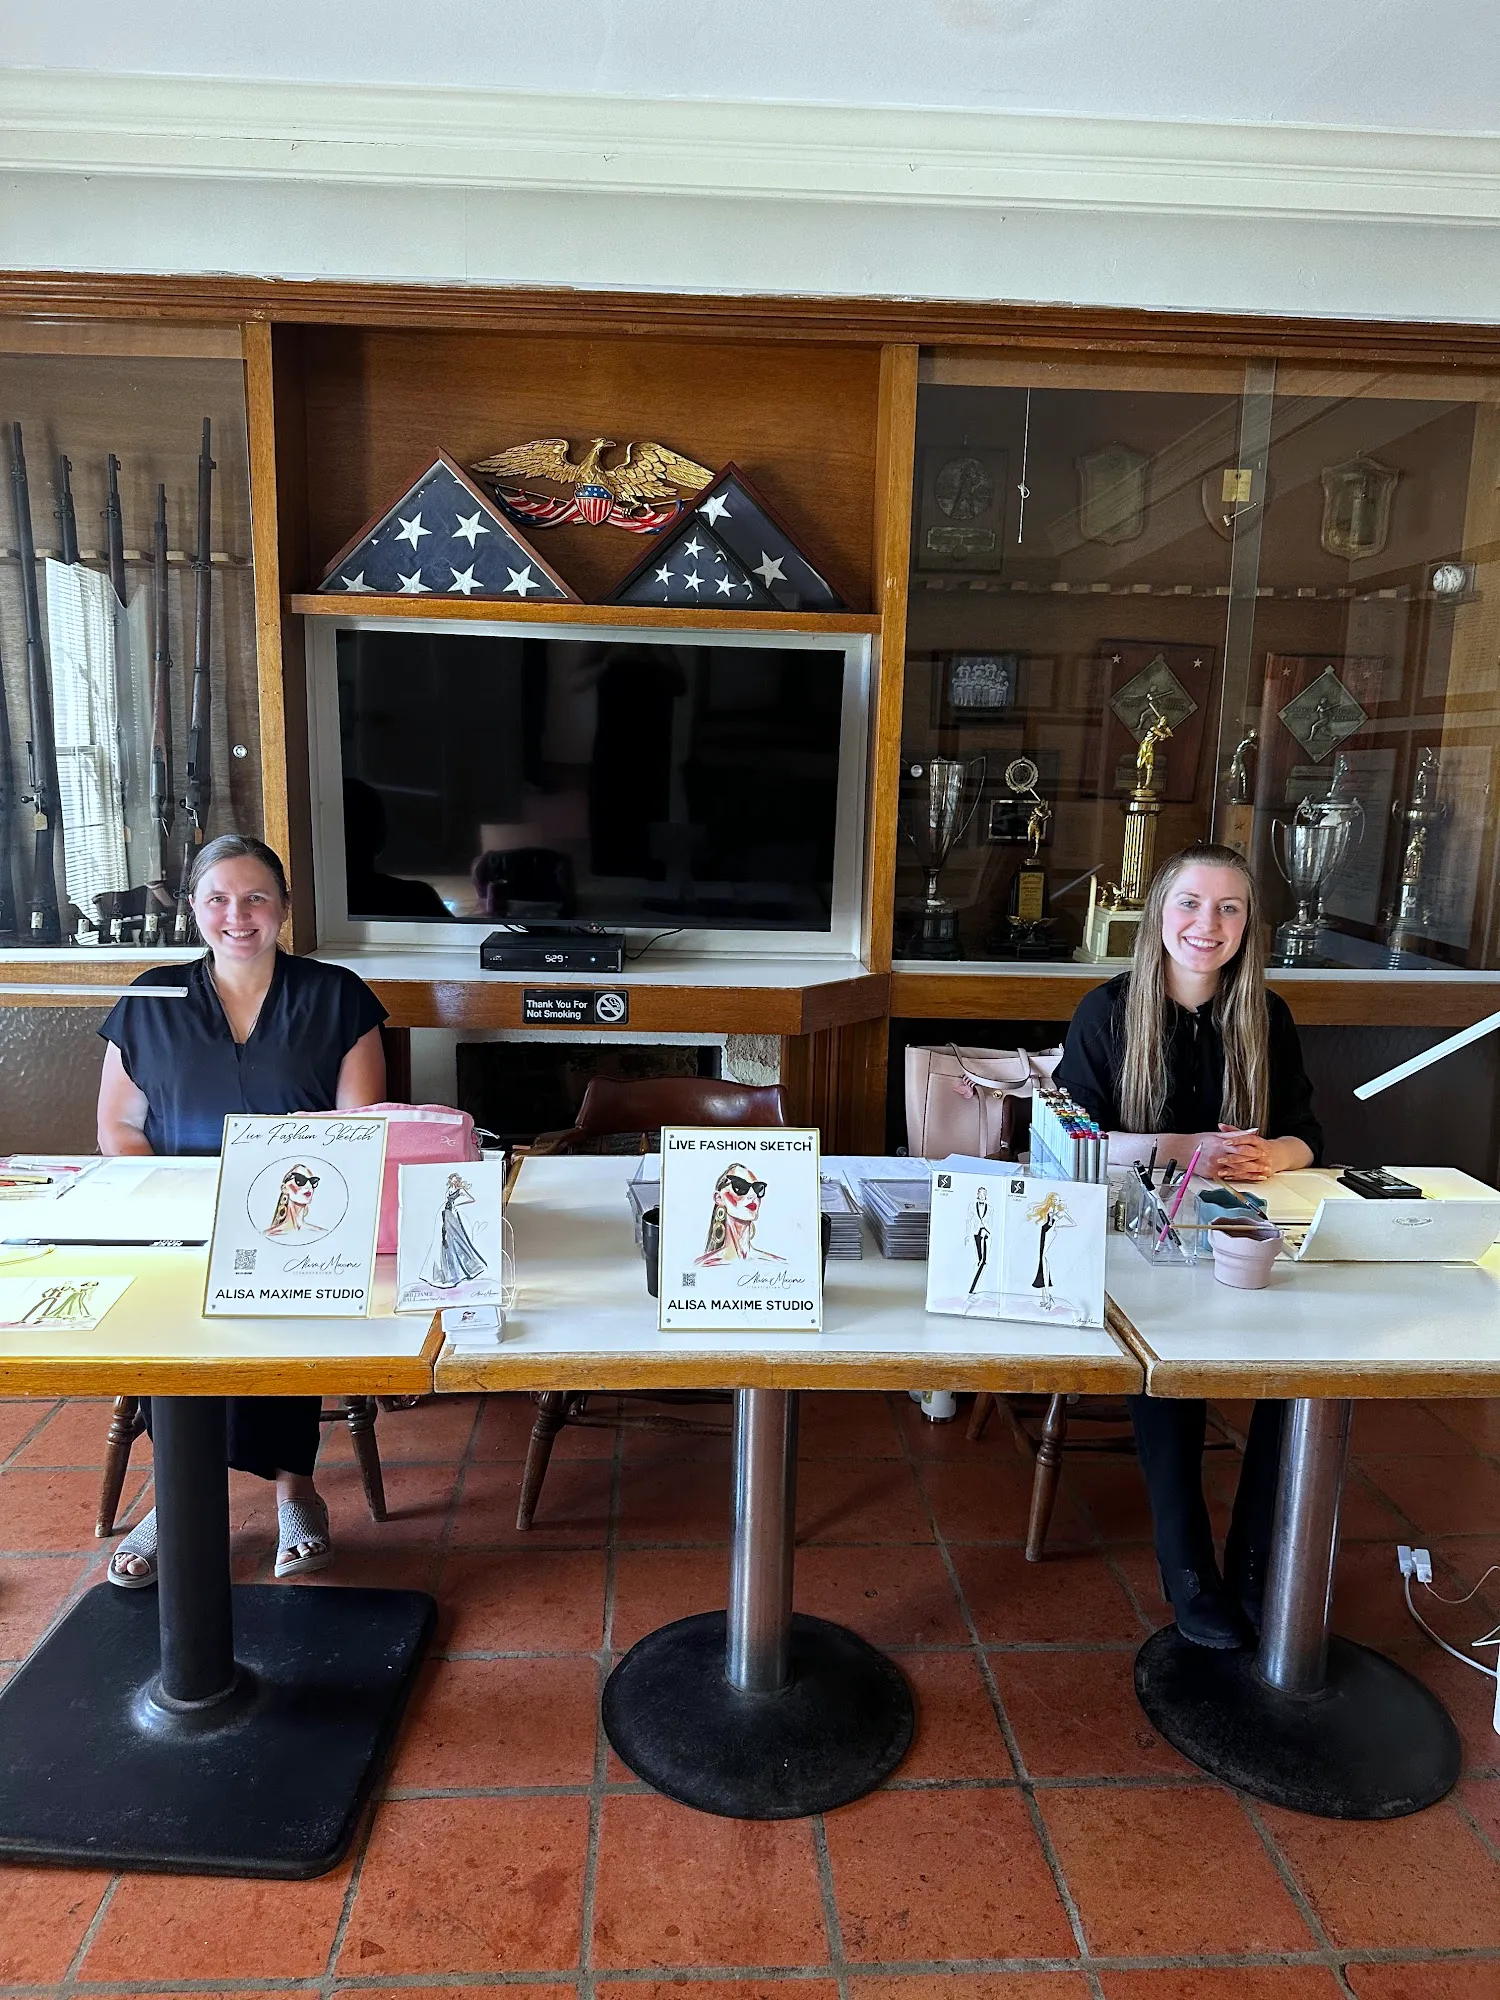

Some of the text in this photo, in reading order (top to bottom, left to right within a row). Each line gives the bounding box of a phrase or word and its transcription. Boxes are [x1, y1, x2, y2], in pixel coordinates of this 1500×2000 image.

[526, 1000, 588, 1009] Thank You For
[527, 1010, 581, 1020] Not Smoking
[267, 1122, 318, 1146] Fashion
[322, 1122, 378, 1146] Sketch
[669, 1140, 812, 1151] LIVE FASHION SKETCH
[216, 1289, 364, 1299] ALISA MAXIME STUDIO
[667, 1300, 814, 1311] ALISA MAXIME STUDIO
